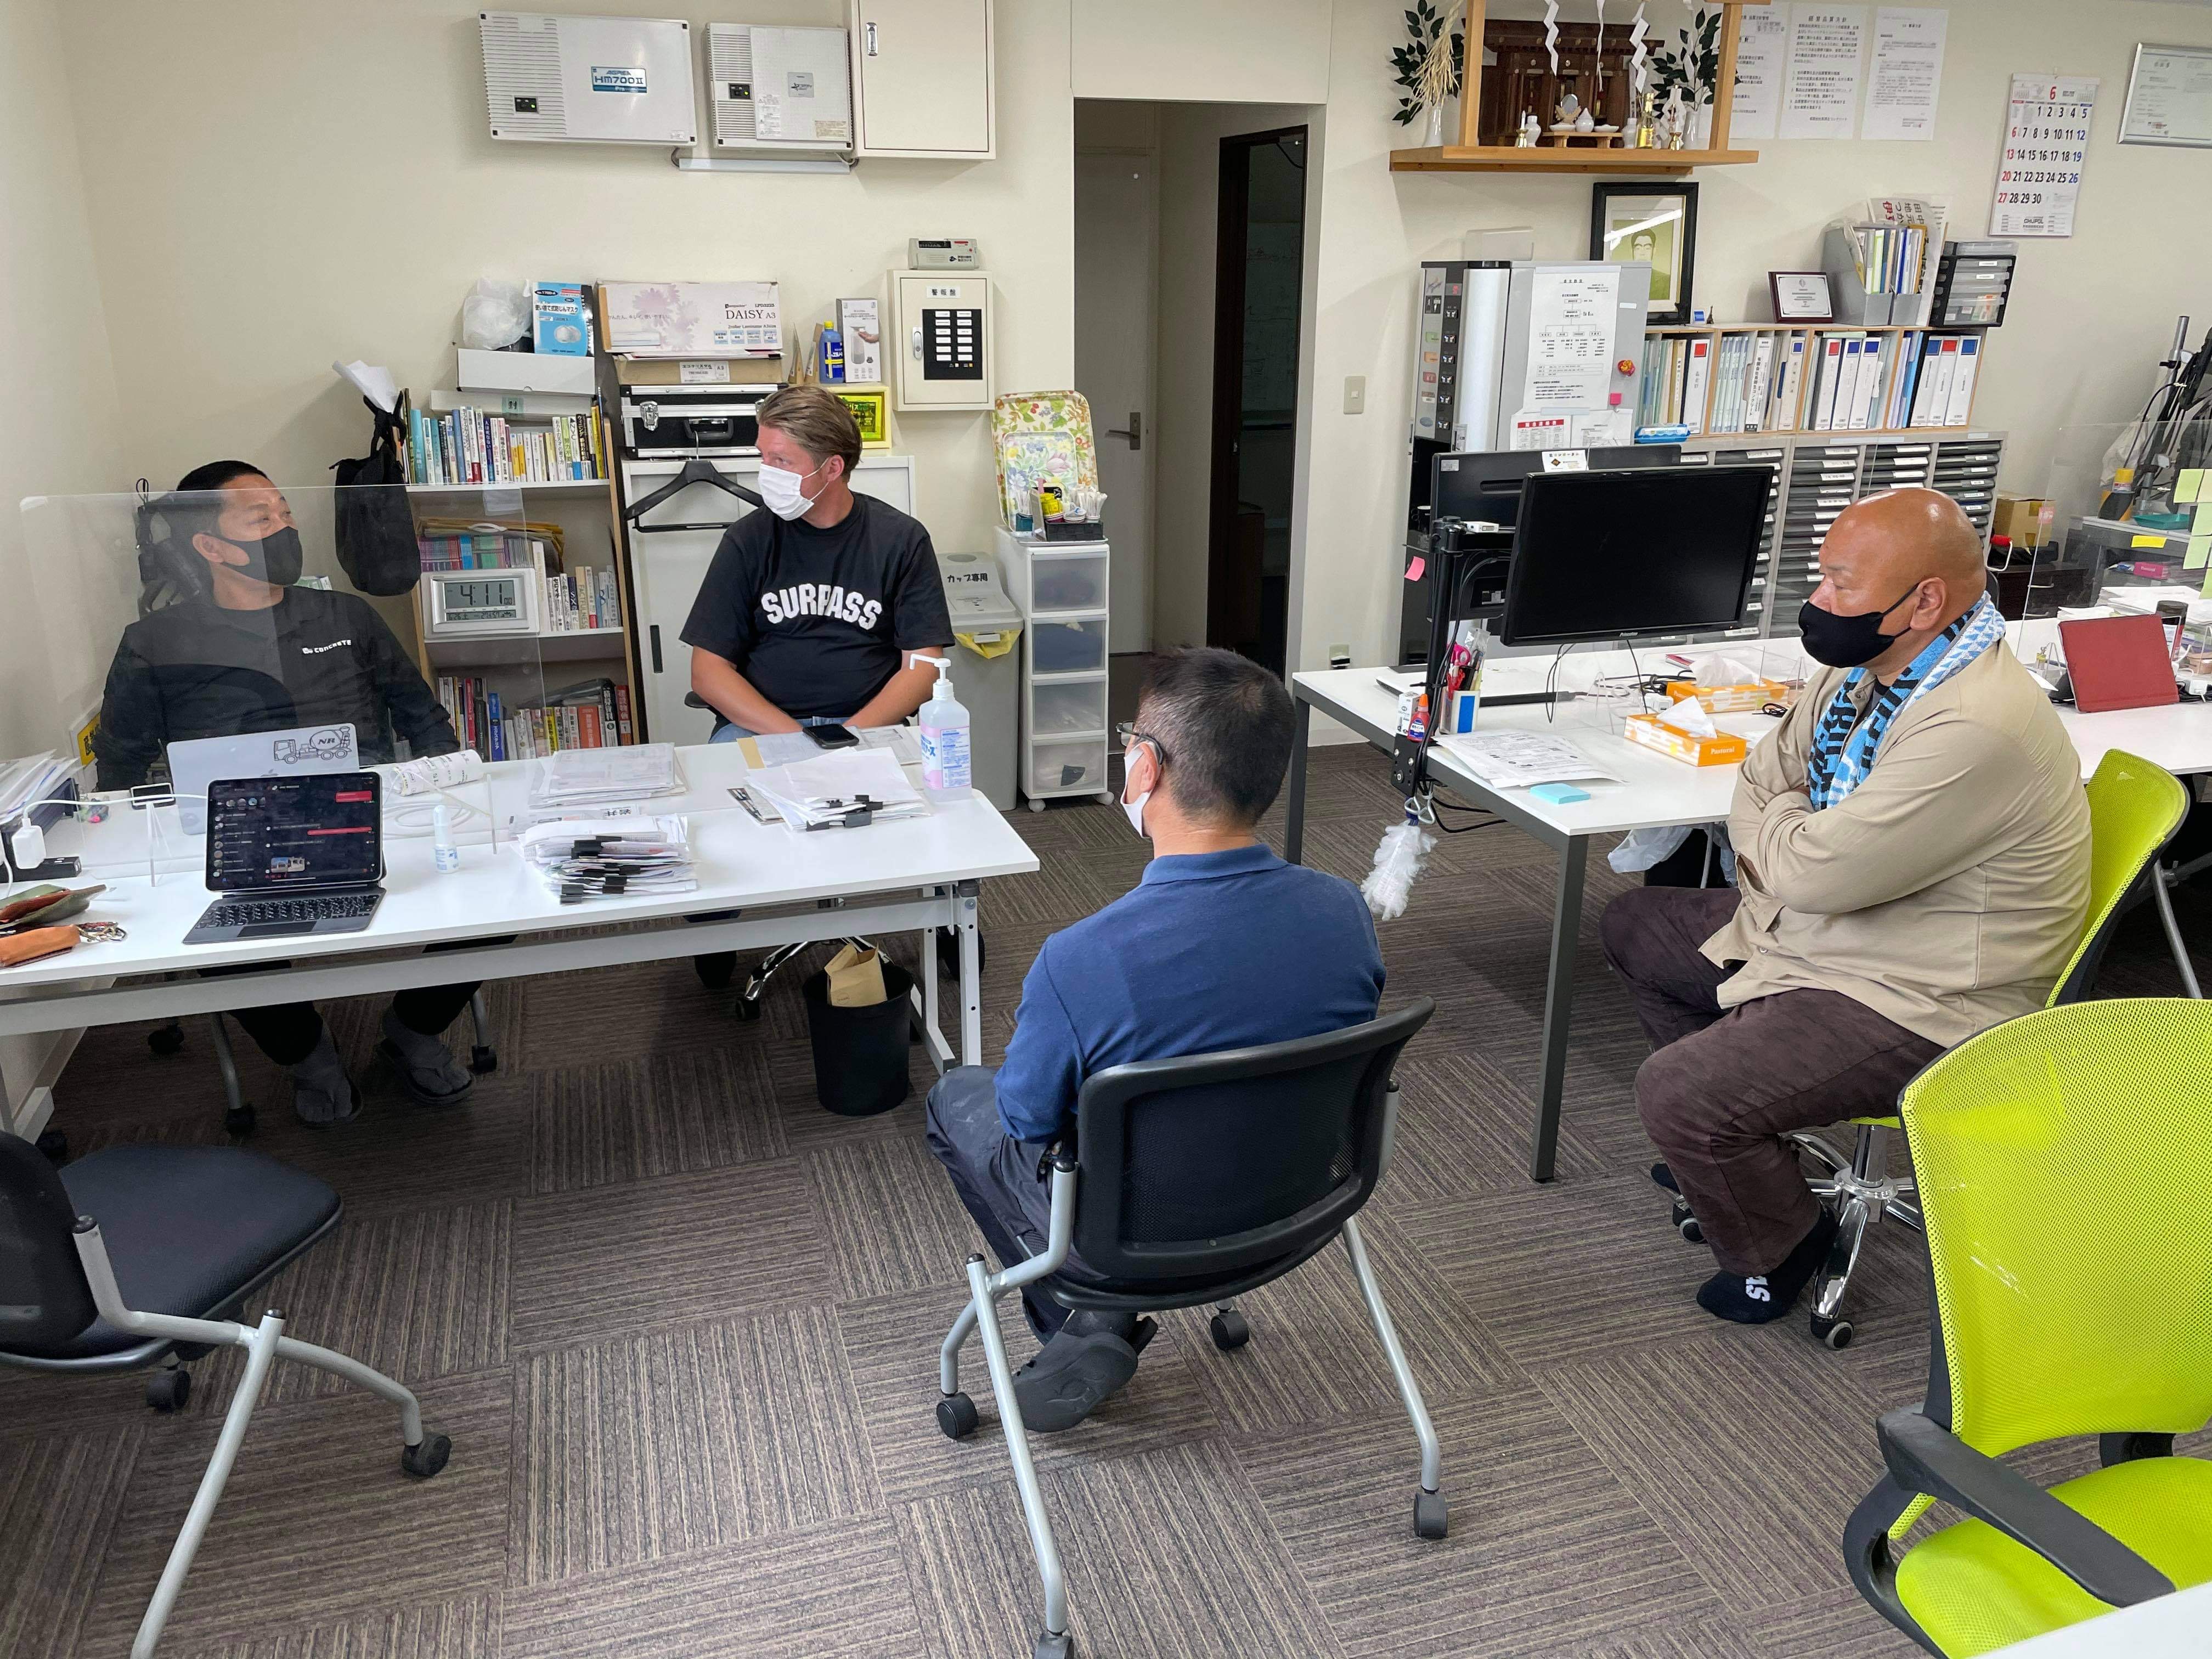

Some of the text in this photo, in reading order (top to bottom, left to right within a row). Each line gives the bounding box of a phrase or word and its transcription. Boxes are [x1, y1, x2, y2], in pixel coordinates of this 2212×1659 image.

[2050, 86, 2057, 100] 6
[2038, 106, 2087, 119] 1 2 3 4 5
[2012, 127, 2085, 140] 6 7 8 9 10 11 12
[2007, 149, 2081, 162] 13 14 15 16 17 18 19
[2001, 171, 2078, 183] 20 21 22 23 24 25 26
[1998, 193, 2041, 204] 27 28 29 30
[726, 310, 763, 319] DAISY
[947, 573, 988, 583] カップ専用
[460, 583, 503, 606] 4:11
[579, 585, 588, 628] FACTFULNESS
[761, 583, 882, 630] SURPASS
[1711, 746, 1735, 755] Pastoral
